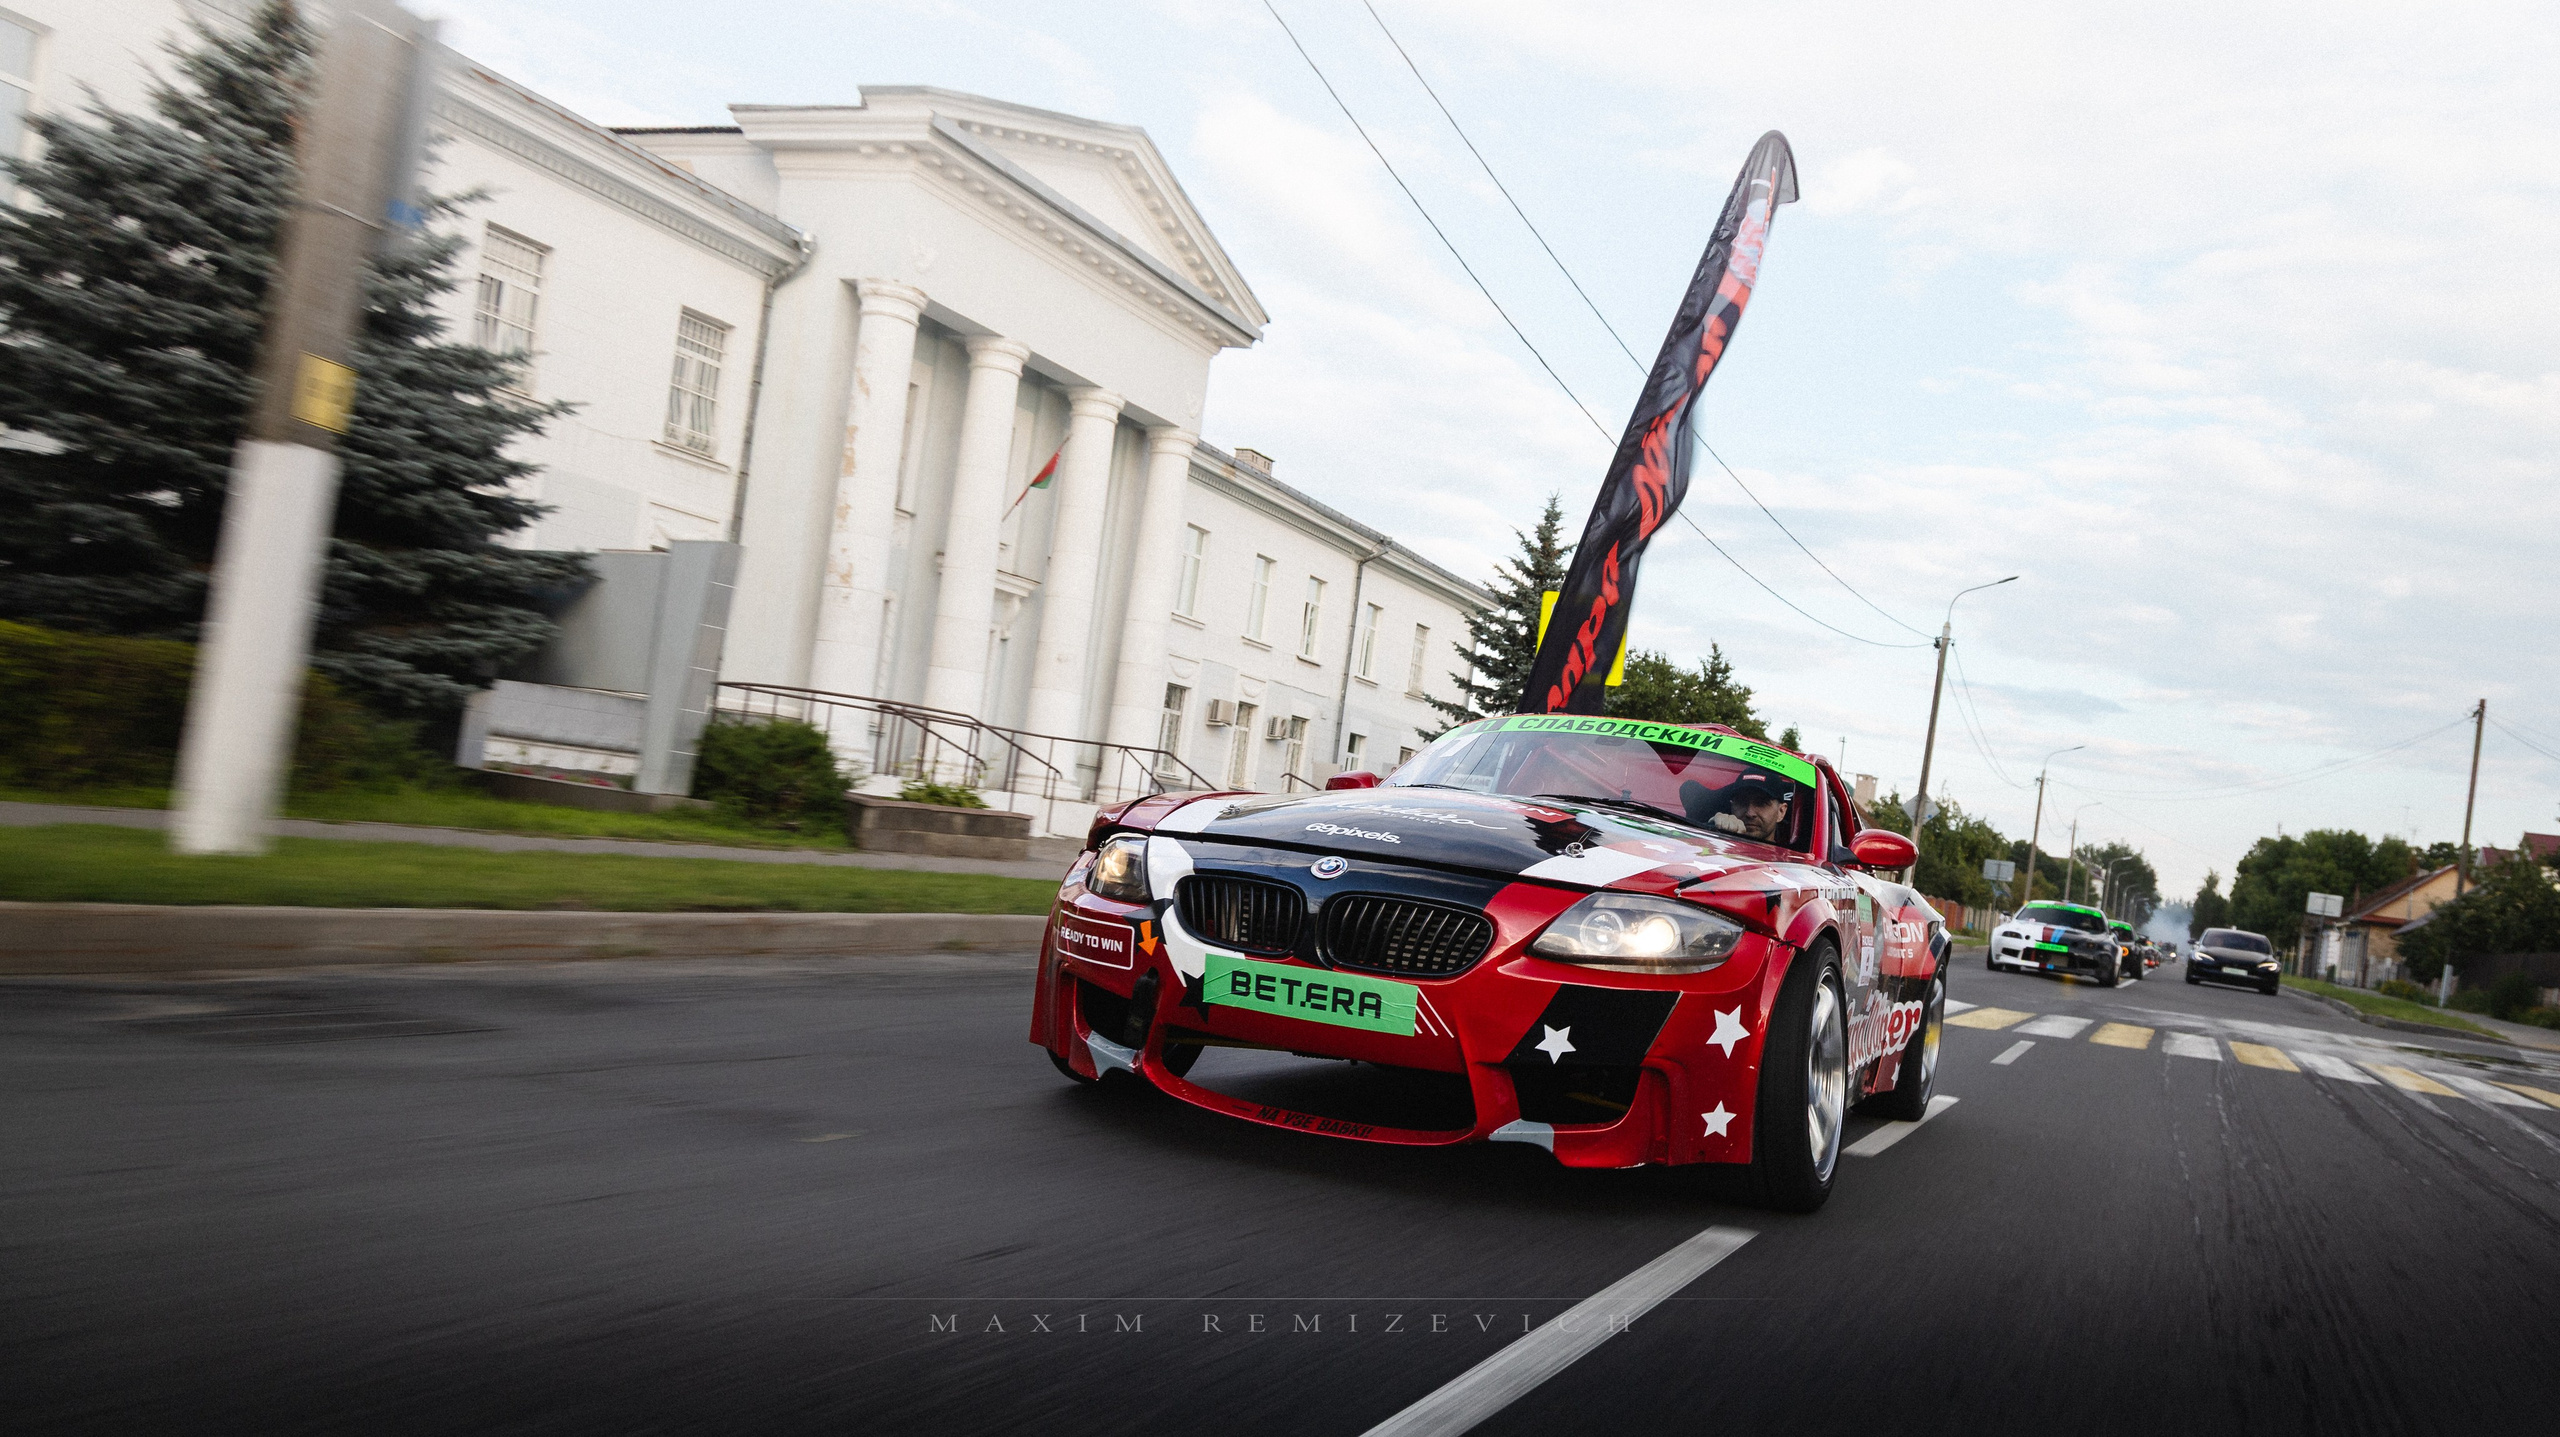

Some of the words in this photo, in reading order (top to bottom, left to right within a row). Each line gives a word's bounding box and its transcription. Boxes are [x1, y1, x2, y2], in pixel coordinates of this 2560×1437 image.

[1517, 717, 1724, 750] СЛАБОДСКИЙ
[1305, 822, 1402, 844] 69pixels.
[1060, 926, 1085, 945] READY
[1085, 934, 1099, 948] TO
[1101, 937, 1123, 953] WIN
[1256, 1106, 1278, 1122] NA
